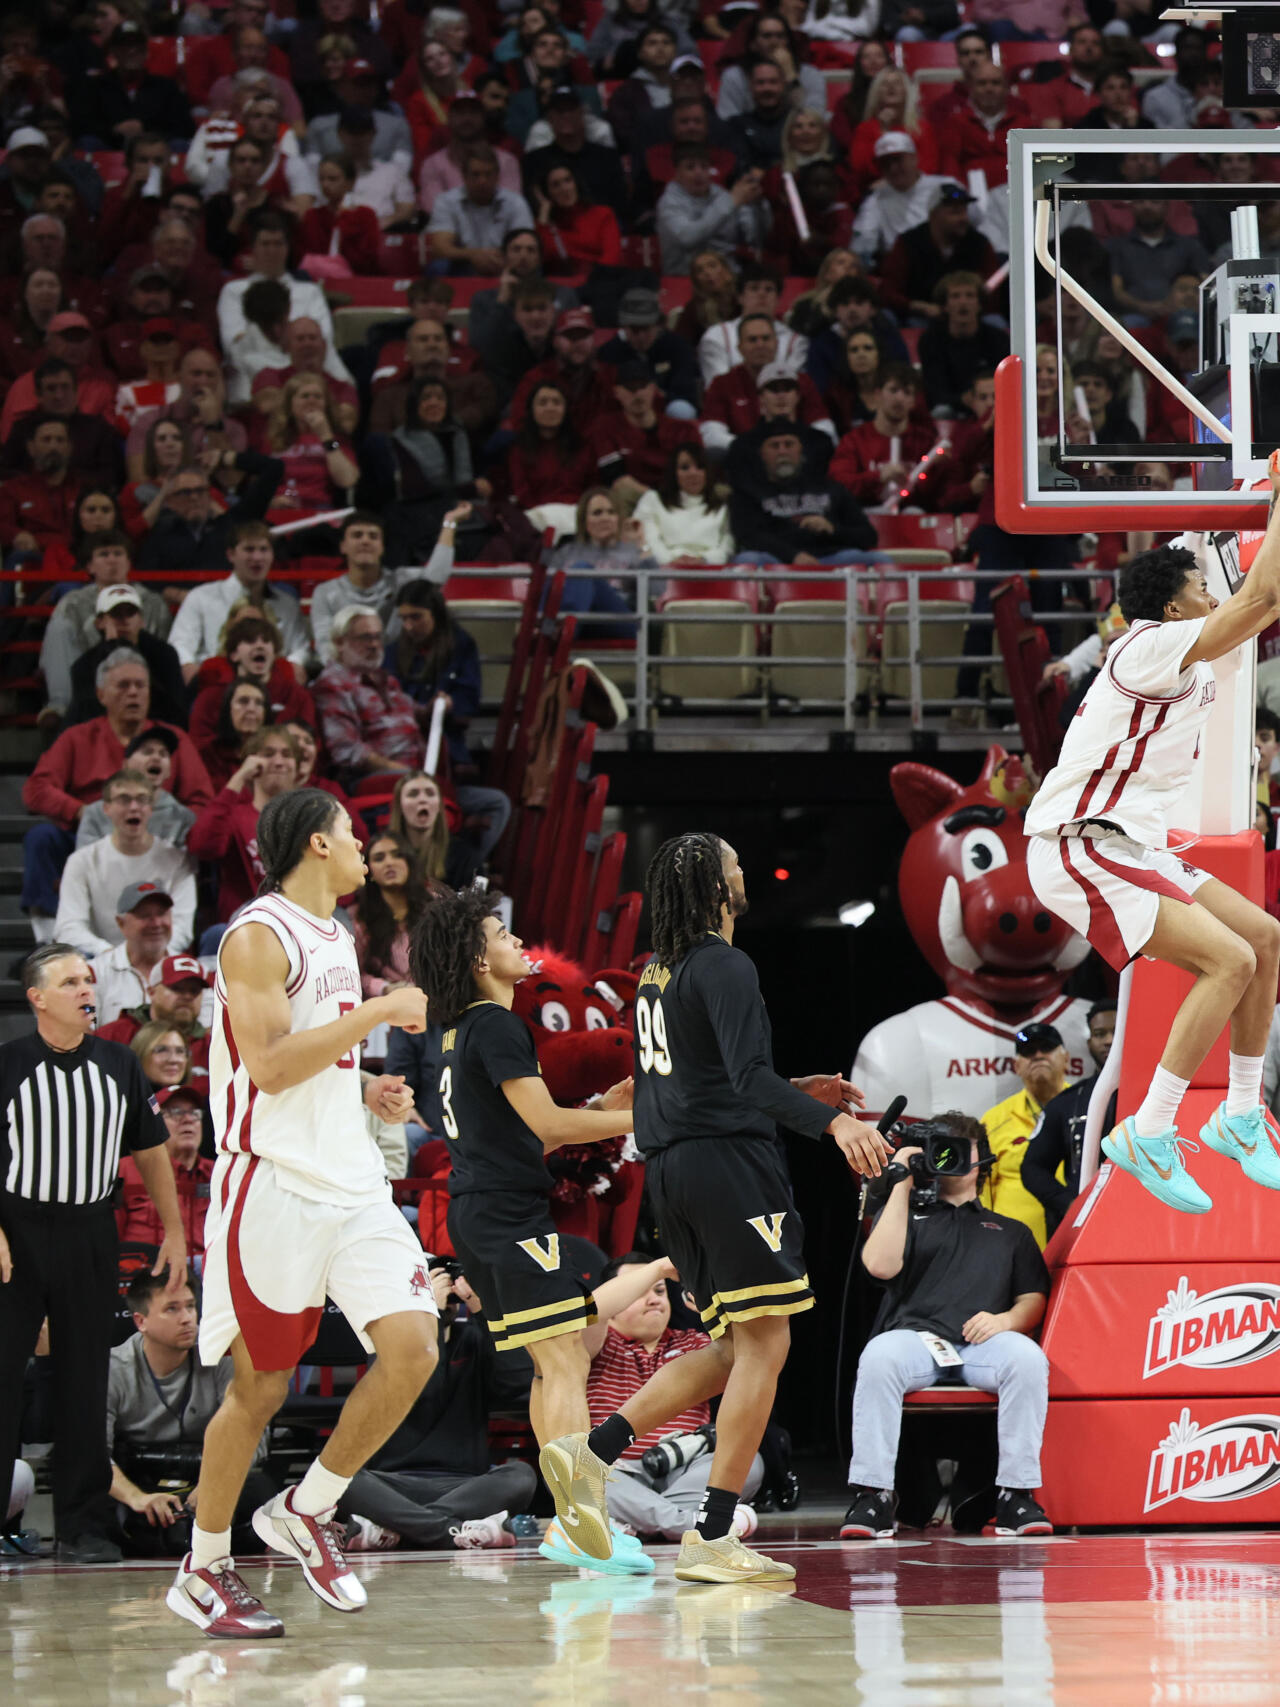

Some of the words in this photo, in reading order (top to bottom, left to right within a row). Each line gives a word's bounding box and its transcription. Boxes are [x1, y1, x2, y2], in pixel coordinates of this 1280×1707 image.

[636, 995, 672, 1076] 99
[946, 1056, 1084, 1078] ARKAS
[438, 1065, 459, 1140] 3
[515, 1232, 561, 1273] V
[745, 1212, 788, 1253] V
